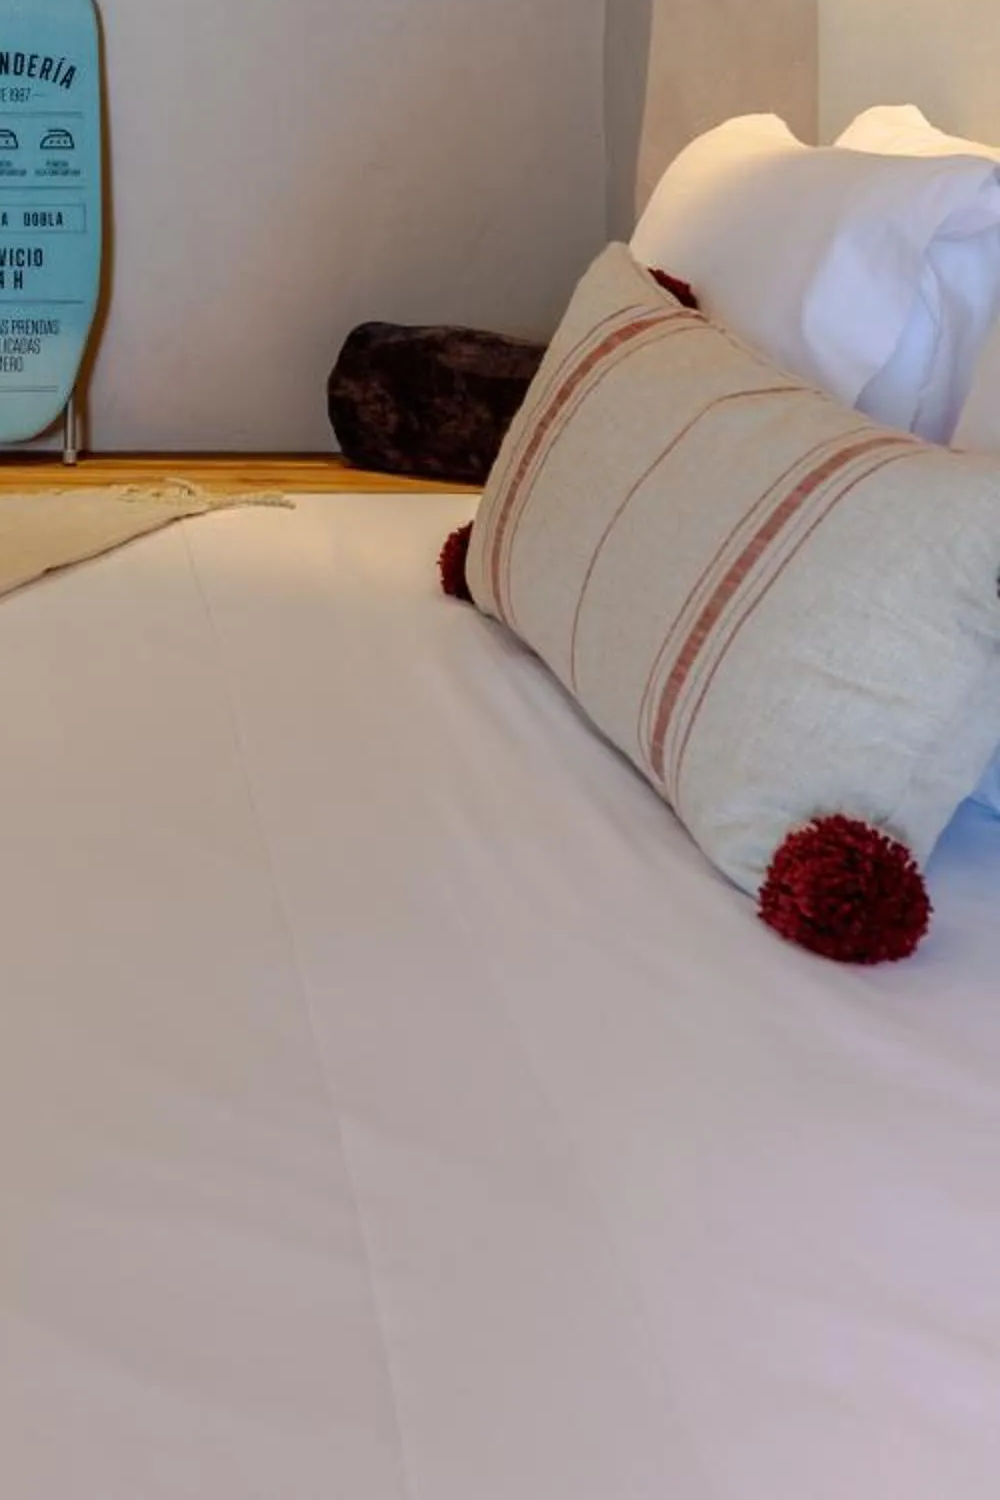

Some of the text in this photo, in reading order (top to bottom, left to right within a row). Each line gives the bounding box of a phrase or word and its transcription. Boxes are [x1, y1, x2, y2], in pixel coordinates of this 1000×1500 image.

[23, 211, 64, 227] DOBLA
[13, 269, 24, 289] H
[11, 319, 60, 335] PRENDAS
